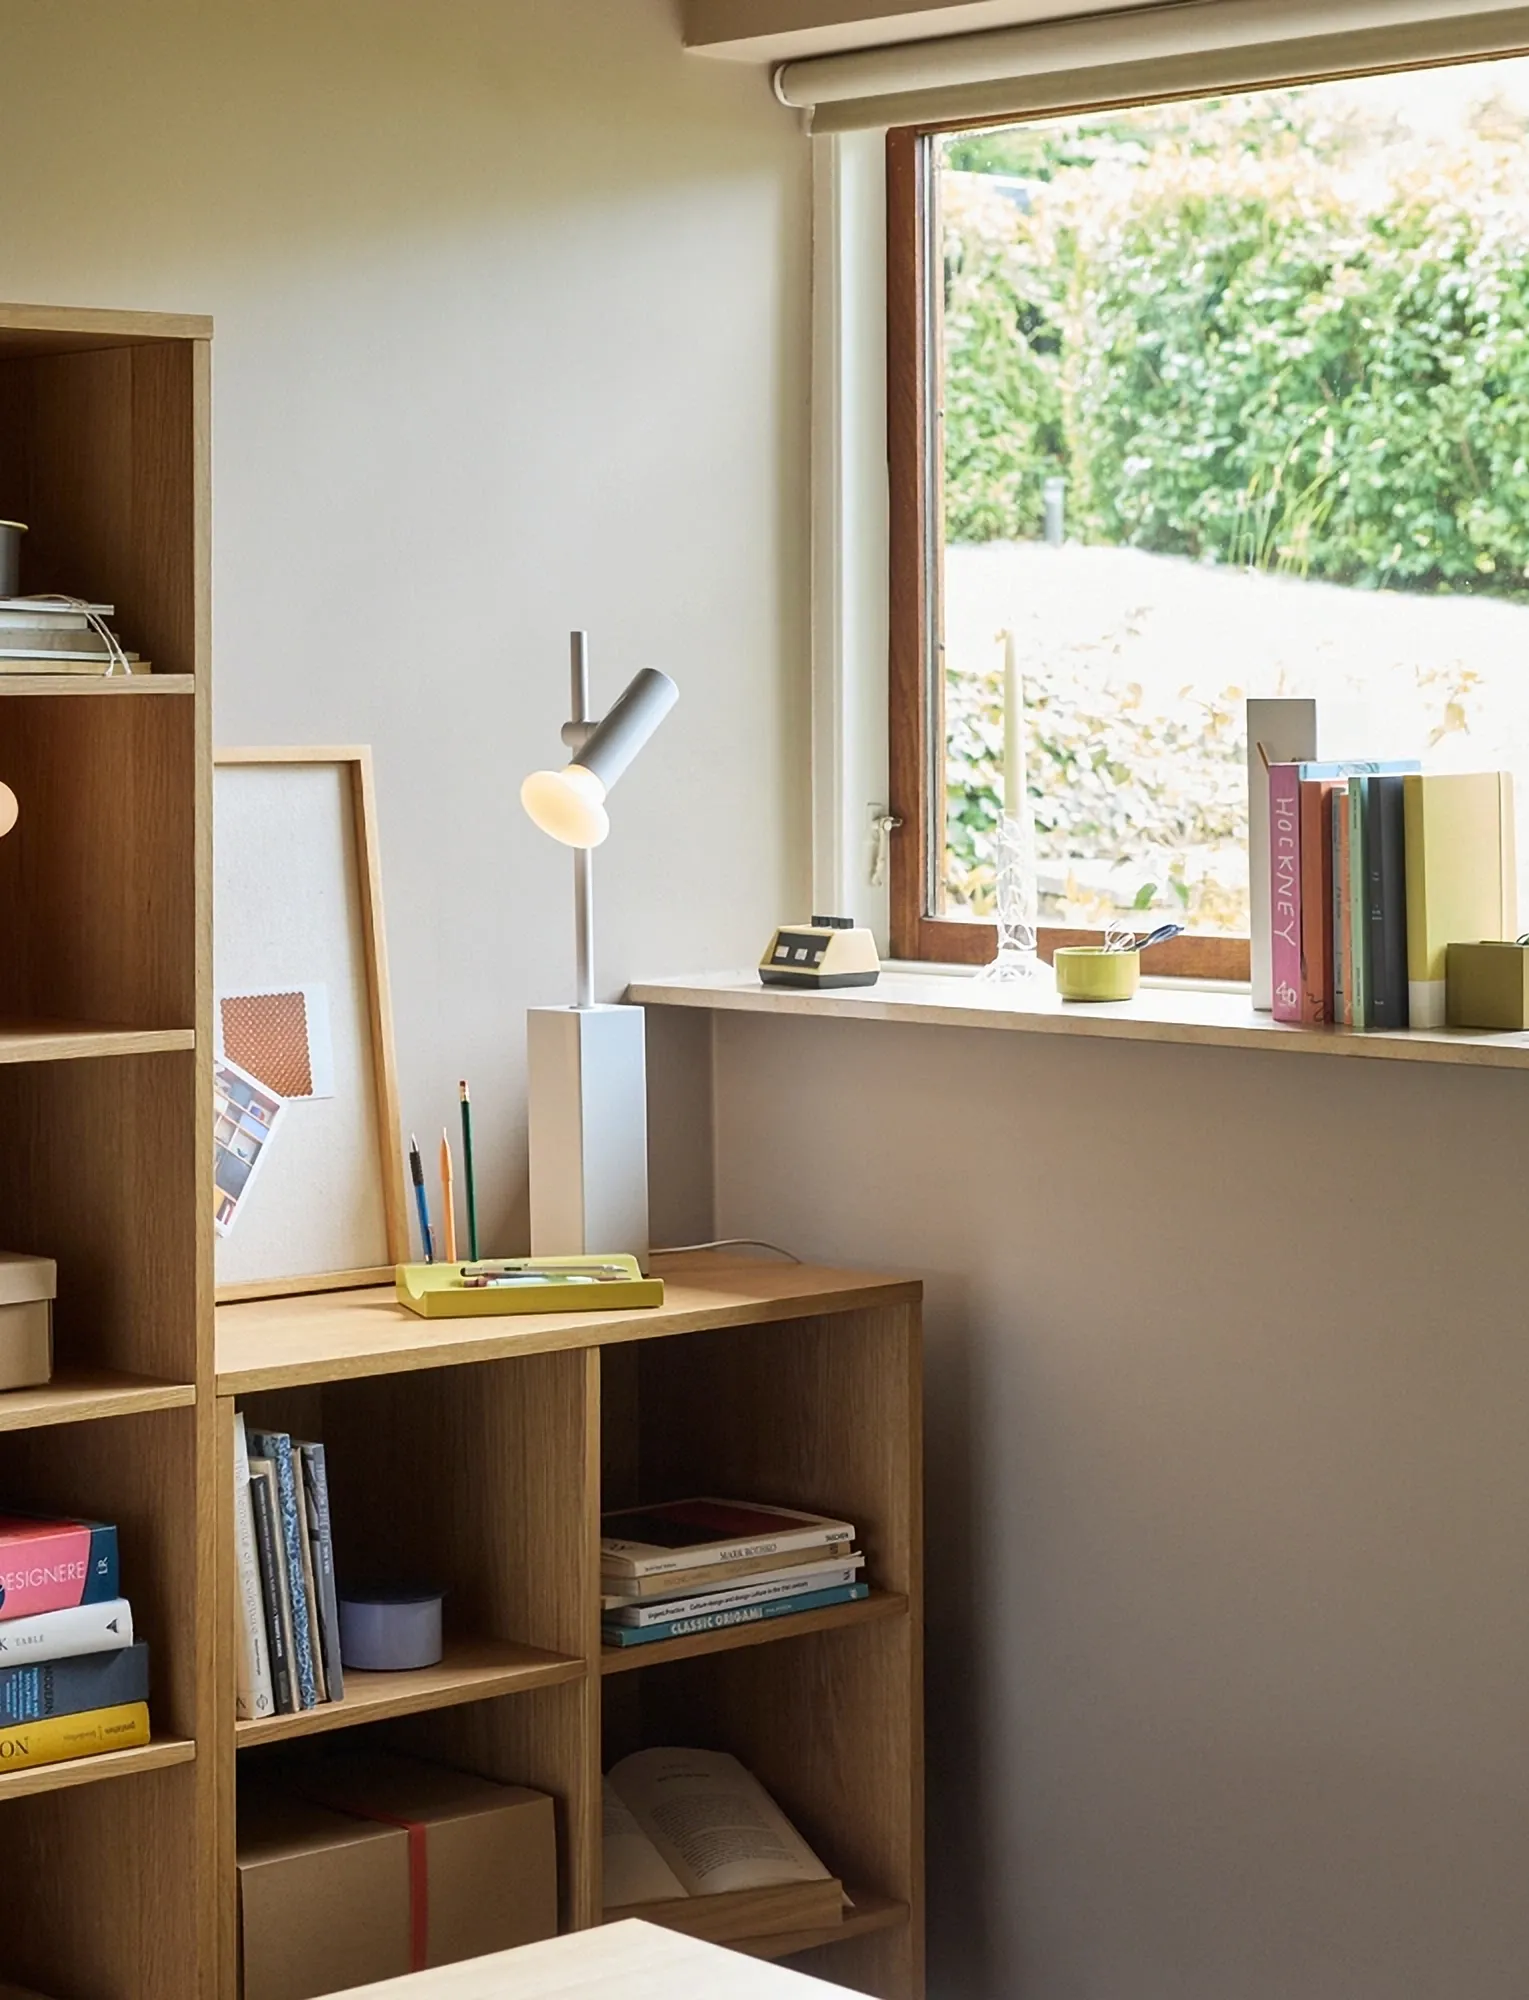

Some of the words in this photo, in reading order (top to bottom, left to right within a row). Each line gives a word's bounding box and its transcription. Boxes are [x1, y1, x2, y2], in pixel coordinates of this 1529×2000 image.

[1273, 797, 1297, 947] HOCKNEY
[671, 1614, 714, 1636] CLASSIC
[715, 1607, 764, 1630] ORIGAMI
